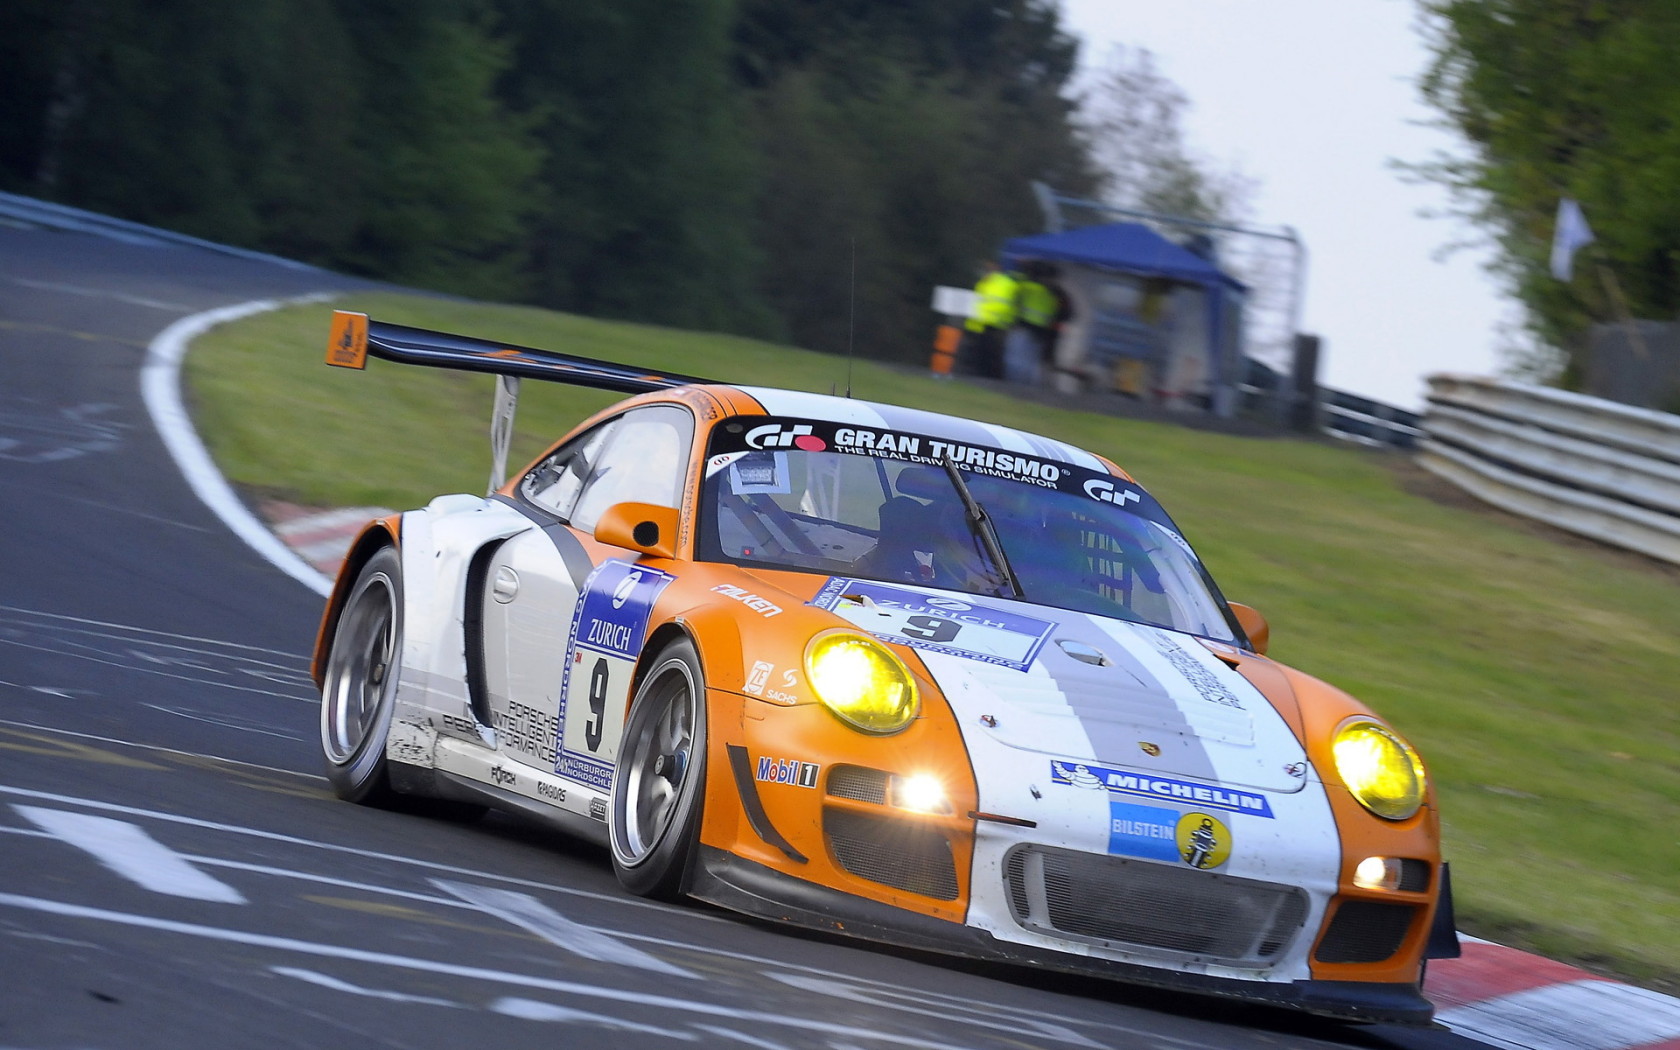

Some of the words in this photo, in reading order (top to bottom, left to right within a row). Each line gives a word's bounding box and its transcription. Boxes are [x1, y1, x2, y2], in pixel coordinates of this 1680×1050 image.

[834, 428, 920, 454] GRAN
[928, 440, 1060, 482] TURISMO
[834, 445, 867, 456] THE
[868, 448, 908, 461] REAL
[973, 465, 1059, 490] SIMULATOR
[709, 583, 784, 618] FALKEN
[881, 599, 1007, 630] ZURICH
[587, 618, 632, 651] ZURICH
[900, 615, 963, 643] 9
[585, 657, 609, 752] 9
[766, 689, 798, 704] SACHS
[493, 711, 558, 745] INTELLIGENT
[509, 700, 559, 731] PORSCHE
[756, 756, 799, 785] Mobil
[1106, 773, 1264, 810] MICHELIN
[1112, 819, 1176, 841] BILSTEIN
